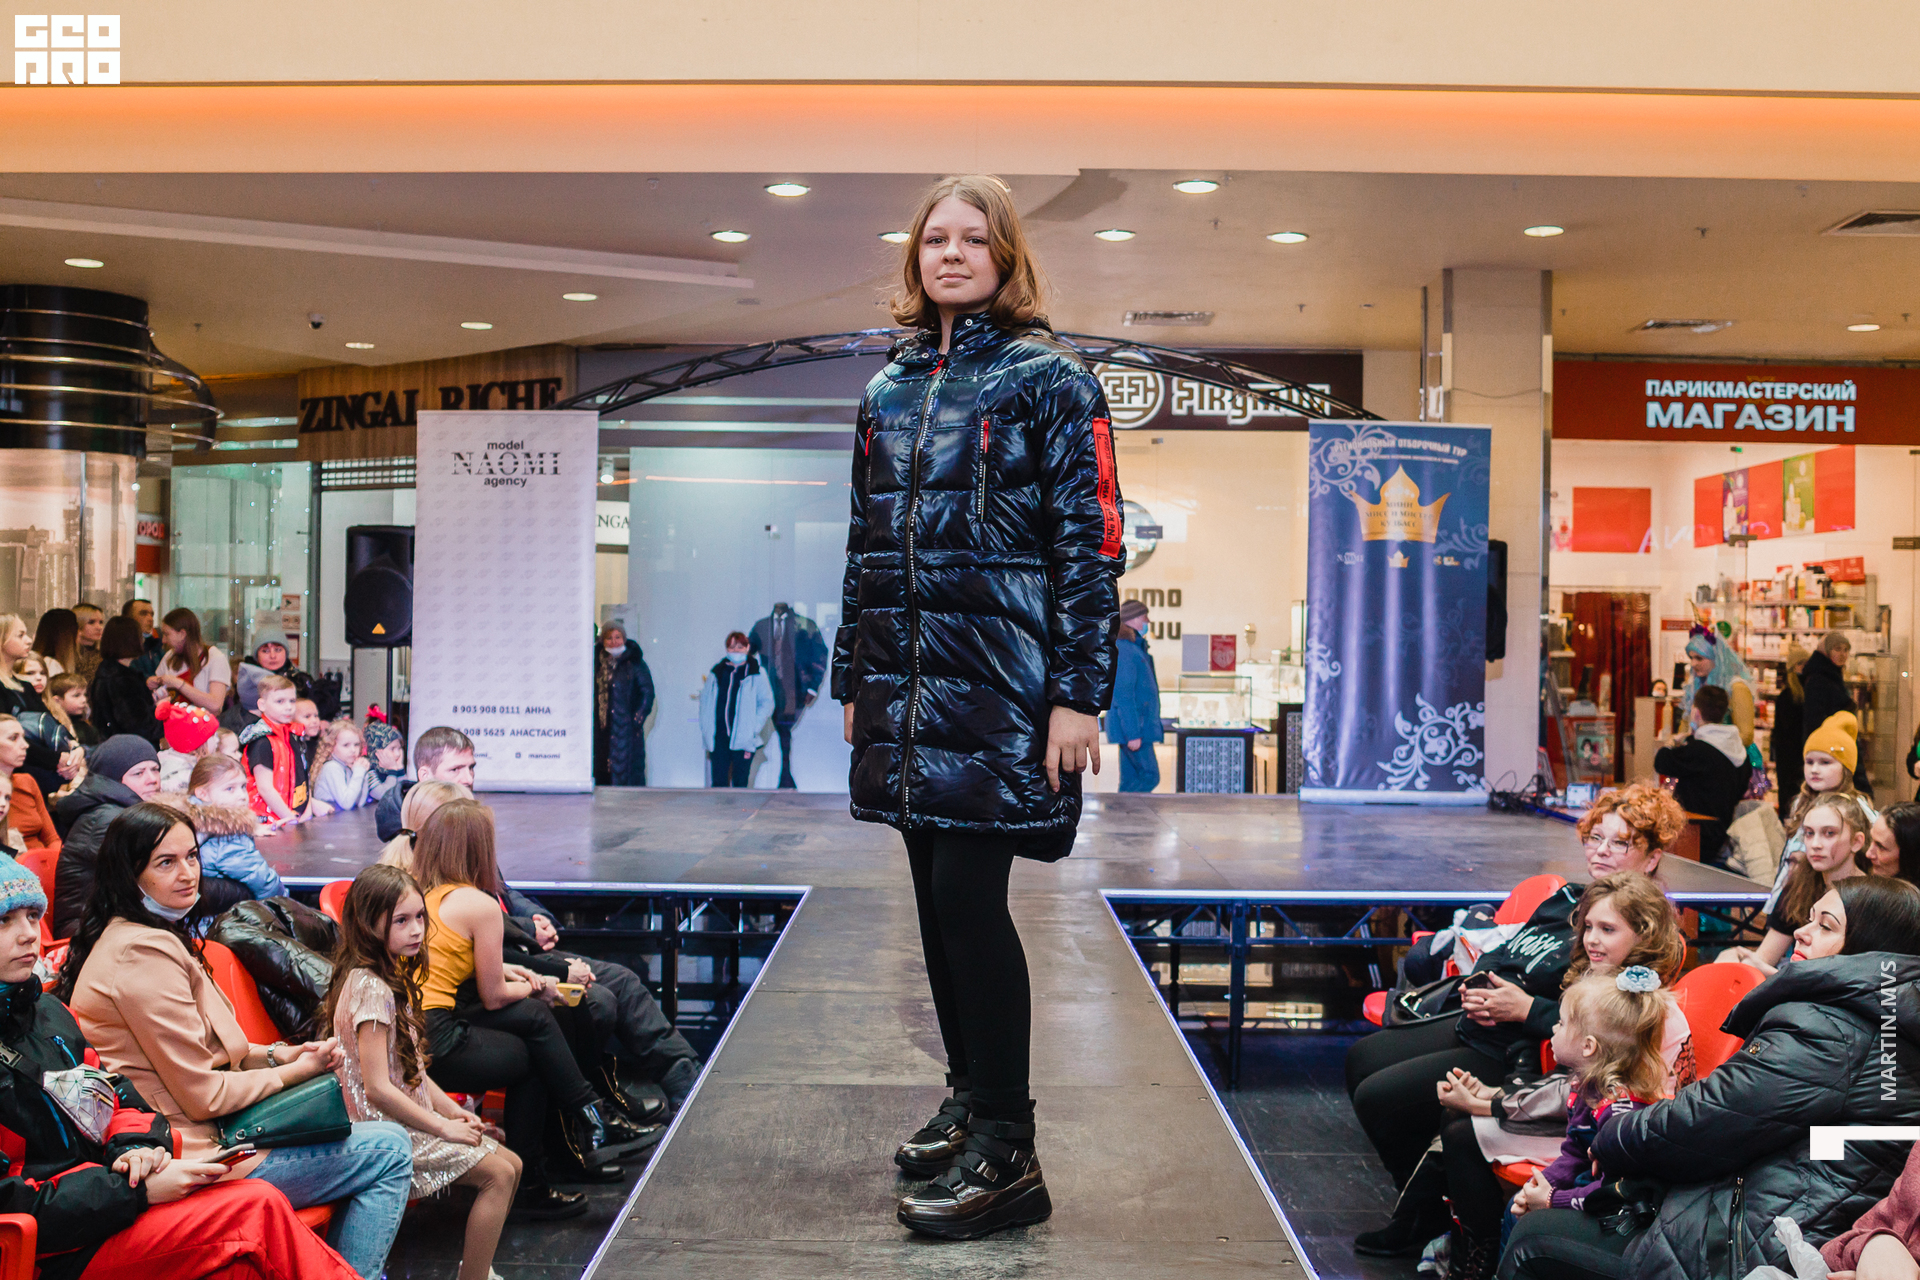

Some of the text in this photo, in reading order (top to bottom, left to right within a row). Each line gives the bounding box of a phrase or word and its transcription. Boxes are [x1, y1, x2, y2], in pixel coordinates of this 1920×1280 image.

[1645, 379, 1857, 401] ПАРИКМАСТЕРСКИЙ
[1645, 401, 1856, 432] МАГАЗИН
[487, 440, 524, 450] model
[451, 452, 561, 475] NAOMI
[484, 477, 527, 488] agency
[452, 705, 551, 715] 8 903 908 0111 АННА
[483, 728, 505, 737] 5625
[510, 728, 567, 738] АНАСТАСИЯ
